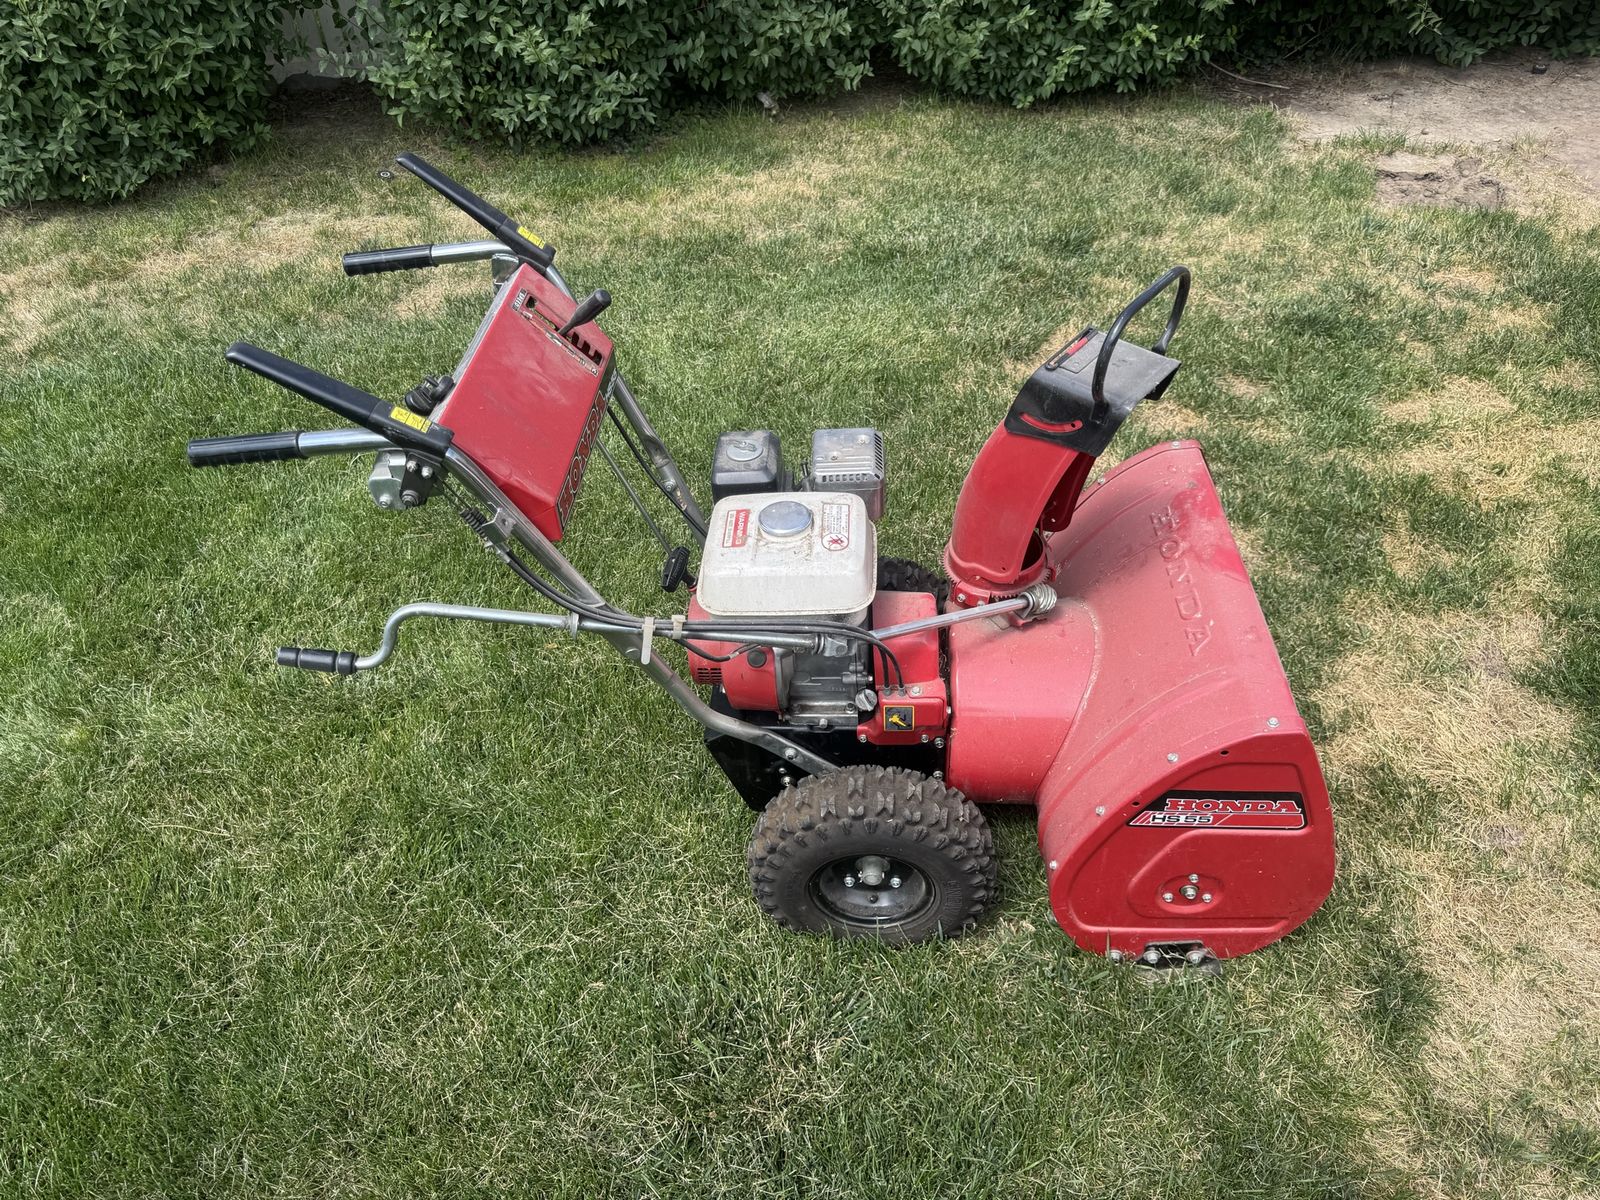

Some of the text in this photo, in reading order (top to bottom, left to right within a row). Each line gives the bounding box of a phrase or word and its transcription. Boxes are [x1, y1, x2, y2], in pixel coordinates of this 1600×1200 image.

[558, 390, 607, 528] HONDA
[1150, 505, 1214, 657] HONDA
[1151, 814, 1212, 824] HS 55
[1164, 798, 1302, 813] HONDA
